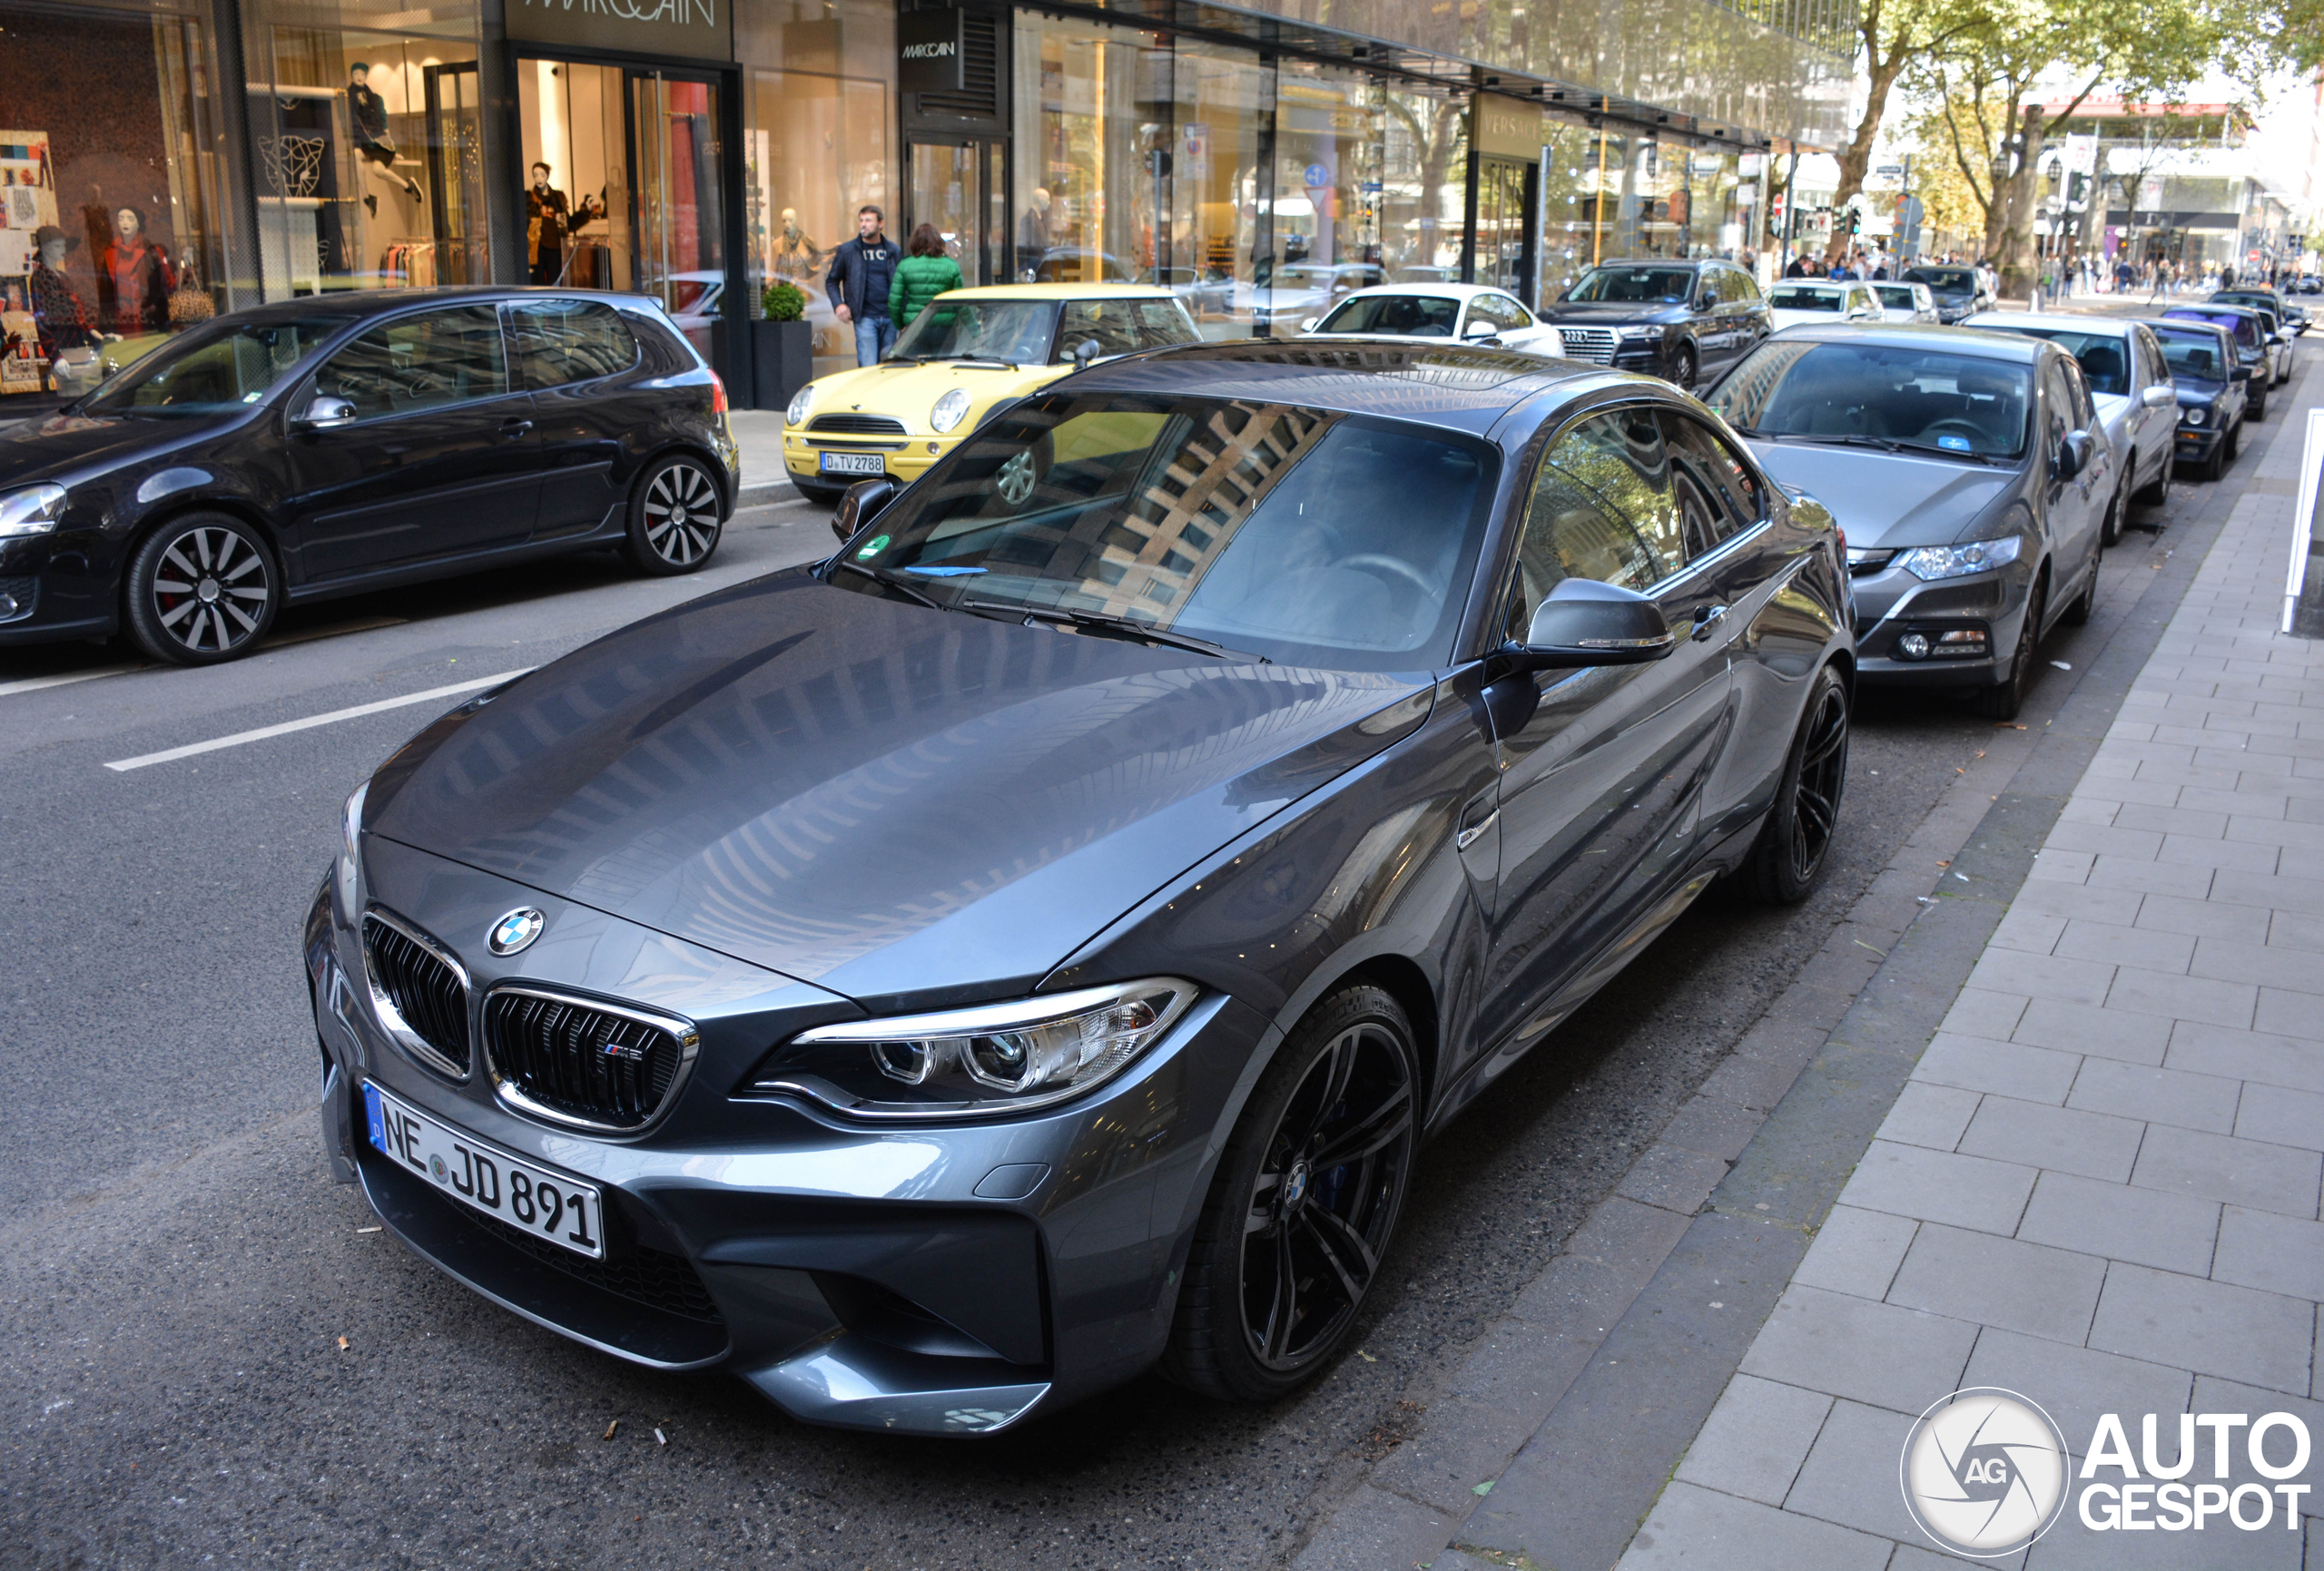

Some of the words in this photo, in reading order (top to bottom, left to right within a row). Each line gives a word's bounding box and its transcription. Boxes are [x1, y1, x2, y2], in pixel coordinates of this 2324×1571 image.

[826, 455, 833, 468] D
[839, 456, 853, 470] TV
[854, 457, 881, 471] 2788
[381, 1101, 428, 1173] NE
[450, 1142, 502, 1210] JD
[509, 1169, 596, 1250] 891
